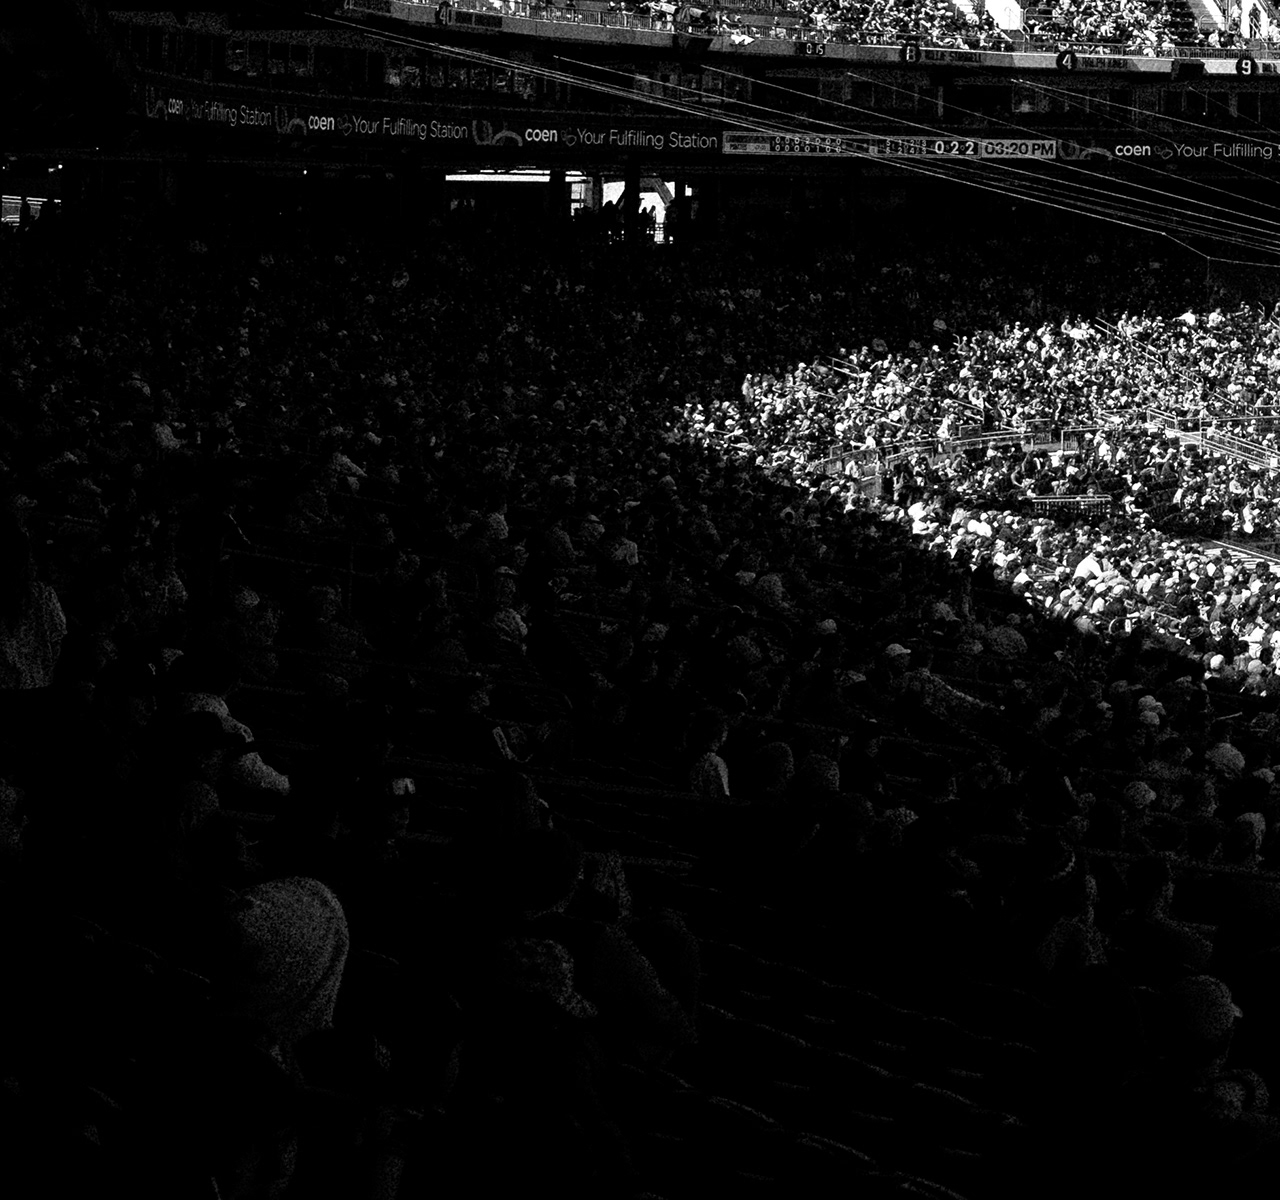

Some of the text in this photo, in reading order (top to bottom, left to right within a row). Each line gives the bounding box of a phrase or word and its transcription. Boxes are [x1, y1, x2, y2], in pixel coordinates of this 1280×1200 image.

[1062, 54, 1072, 69] 4
[1241, 60, 1251, 74] 9
[240, 105, 272, 126] Station
[308, 115, 468, 141] coen Your Fulfilling Station
[525, 128, 558, 142] coen
[577, 128, 606, 145] Your
[609, 129, 664, 150] Fulfilling
[668, 131, 718, 148] Station
[935, 141, 975, 154] 0 2 2
[985, 142, 1054, 155] 03:20 PM
[1115, 143, 1151, 157] coen
[1173, 143, 1206, 157] Your
[1213, 142, 1272, 160] Fulfilling
